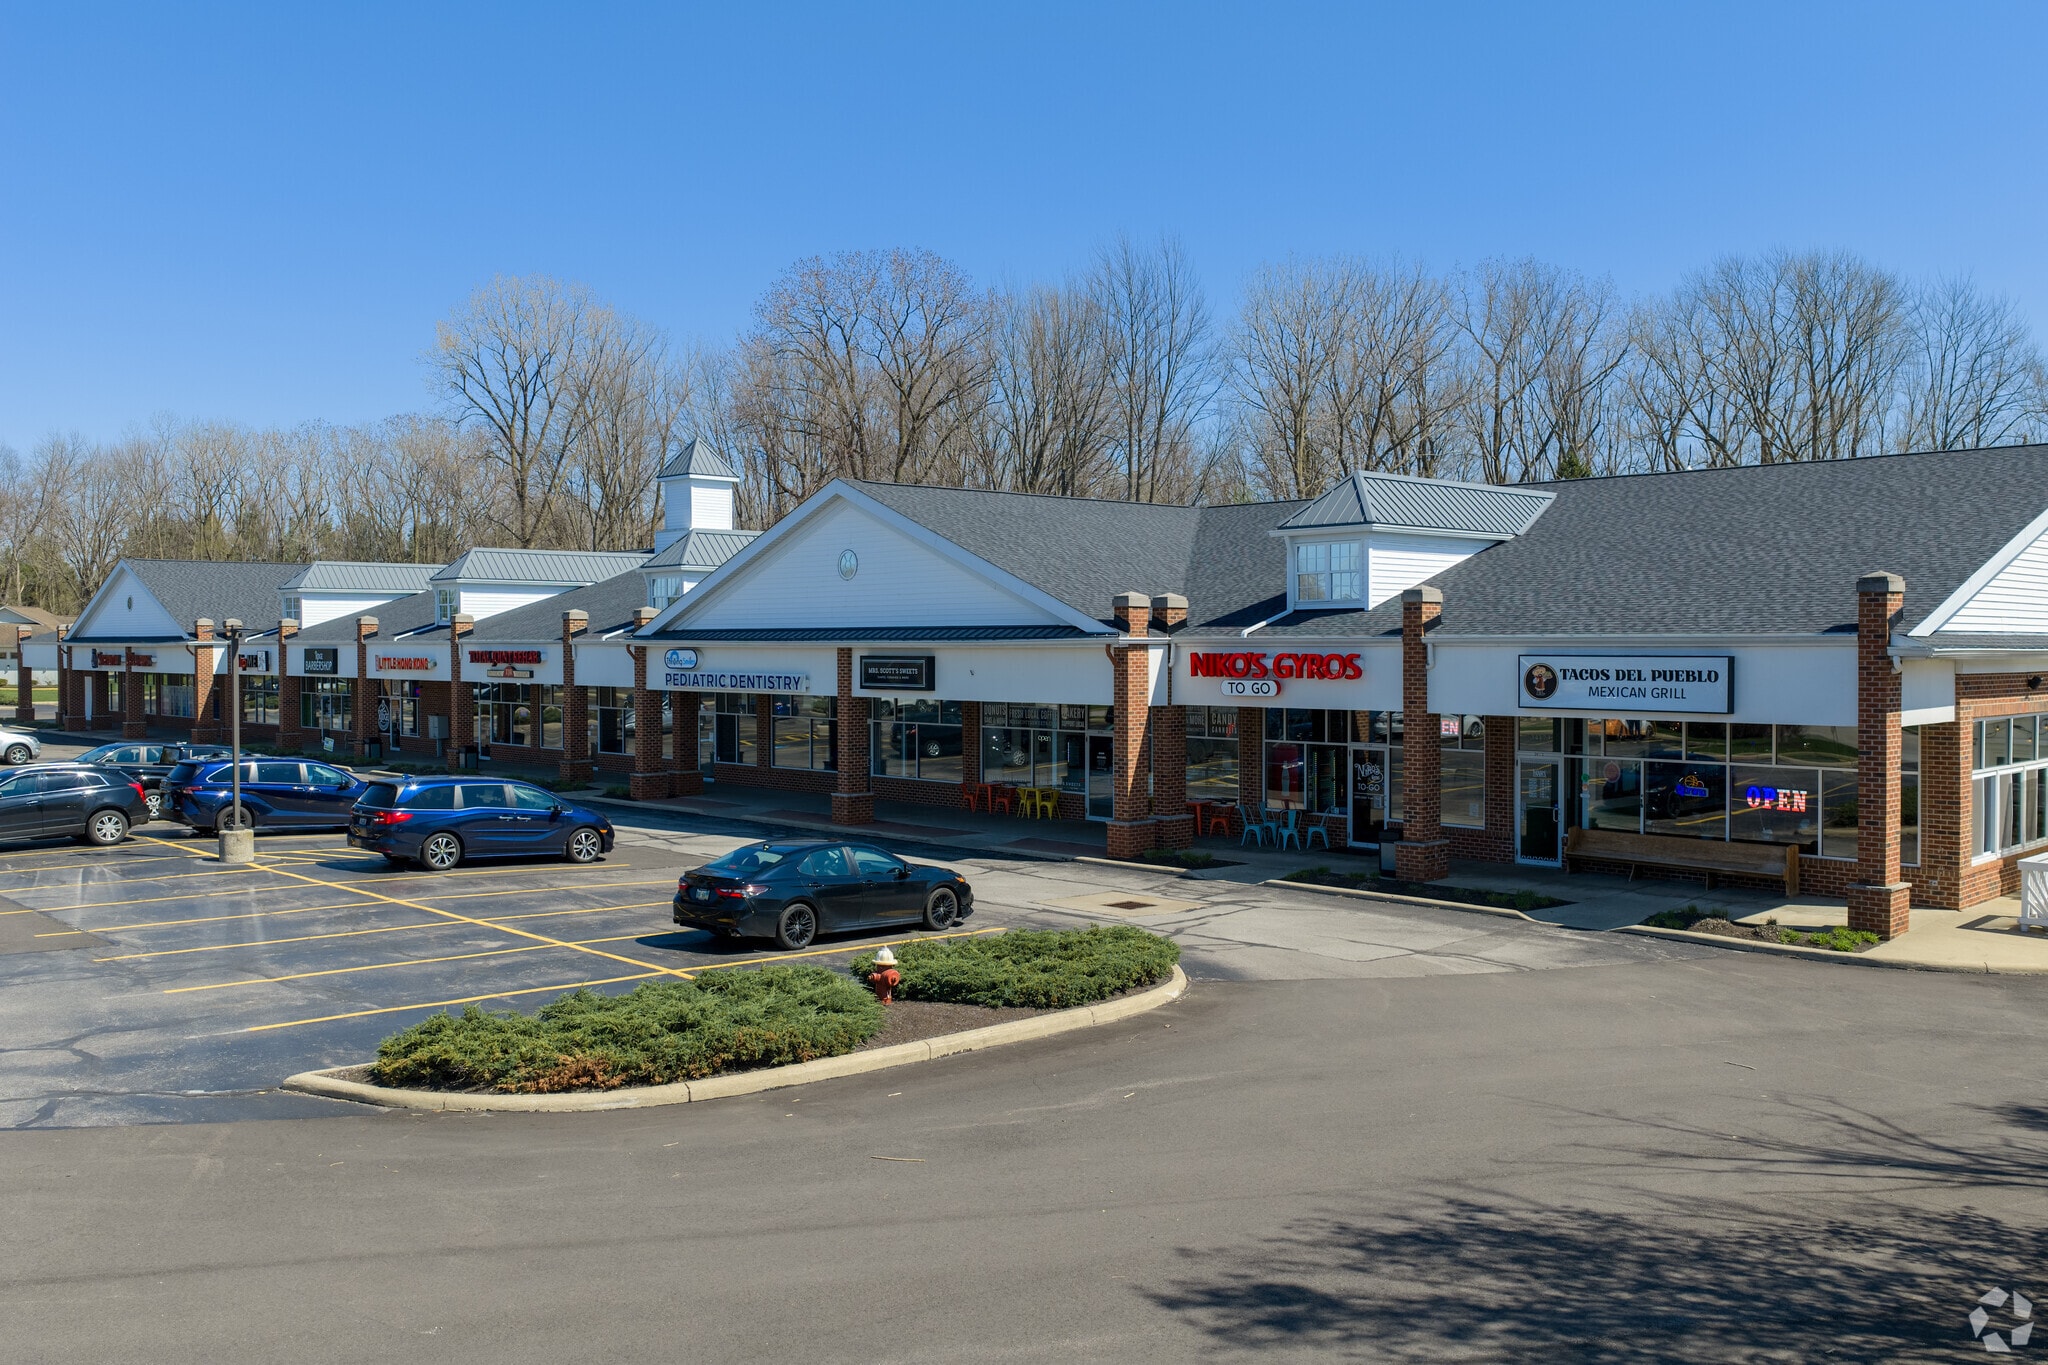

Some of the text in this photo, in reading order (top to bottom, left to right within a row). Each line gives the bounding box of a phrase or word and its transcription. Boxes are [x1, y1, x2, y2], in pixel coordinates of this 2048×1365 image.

[305, 660, 333, 671] BARBERSHOP
[377, 656, 428, 670] LITTLE HONG KONG
[1190, 652, 1363, 680] NIKO'S GYROS
[665, 673, 801, 691] PEDIATRIC DENTISTRY
[1559, 668, 1719, 683] TACOS DEL PUEBLO
[1227, 682, 1271, 695] TO GO
[1588, 686, 1687, 700] MEXICAN GRILL
[984, 704, 1006, 716] DONUTS
[1061, 707, 1084, 719] BAKERY
[1212, 712, 1238, 725] CANDY
[1441, 719, 1459, 735] EN
[1746, 786, 1807, 812] OPEN
